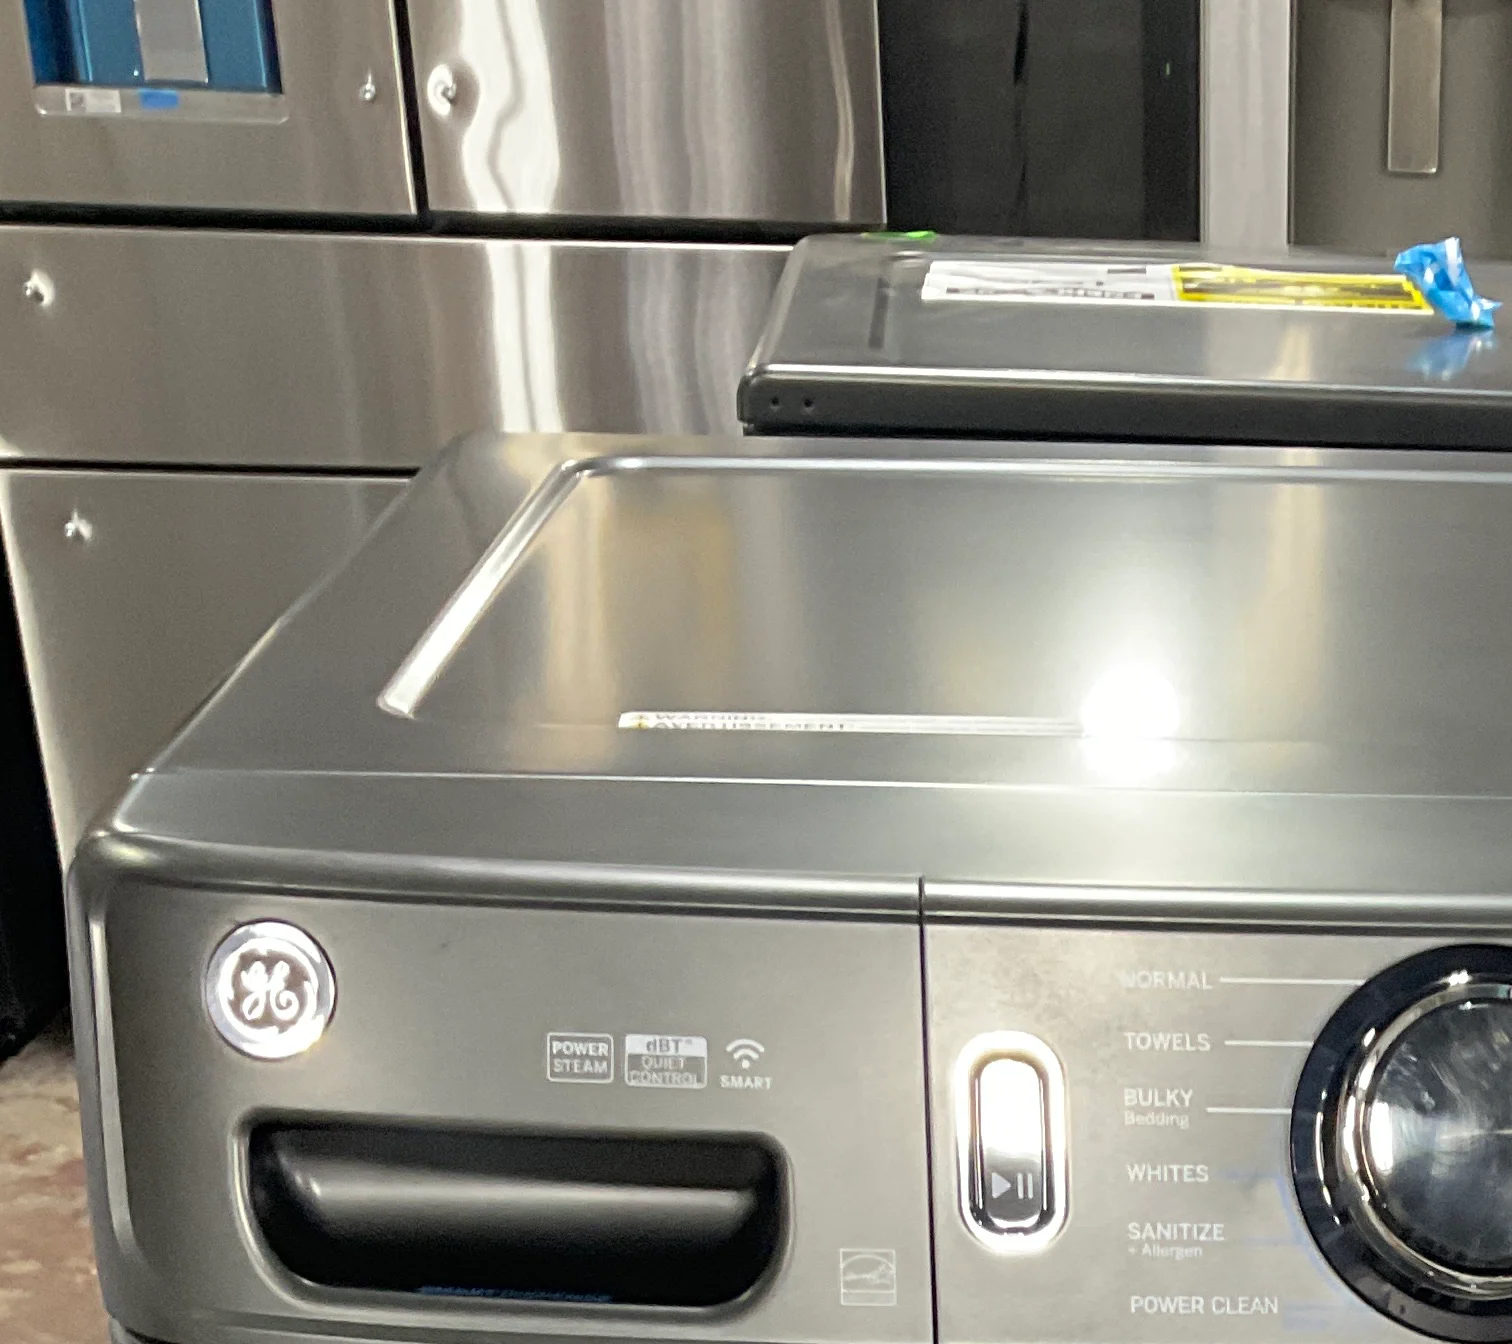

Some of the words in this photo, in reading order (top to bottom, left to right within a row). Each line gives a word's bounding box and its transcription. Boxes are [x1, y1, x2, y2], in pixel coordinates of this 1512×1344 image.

[1121, 970, 1213, 991] NORMAL
[551, 1040, 610, 1057] POWER
[1123, 1032, 1211, 1052] TOWELS
[553, 1058, 609, 1074] STEAM
[641, 1056, 686, 1070] QUIET
[629, 1070, 700, 1086] CONTROL
[719, 1075, 773, 1090] SMART
[1123, 1087, 1193, 1108] BULKY
[1124, 1110, 1190, 1129] Bedding
[1126, 1163, 1210, 1183] WHITES
[1127, 1222, 1225, 1242] SANITIZE
[1142, 1243, 1203, 1261] Allergen
[1130, 1295, 1204, 1315] POWER
[1211, 1296, 1279, 1315] CLEAN
